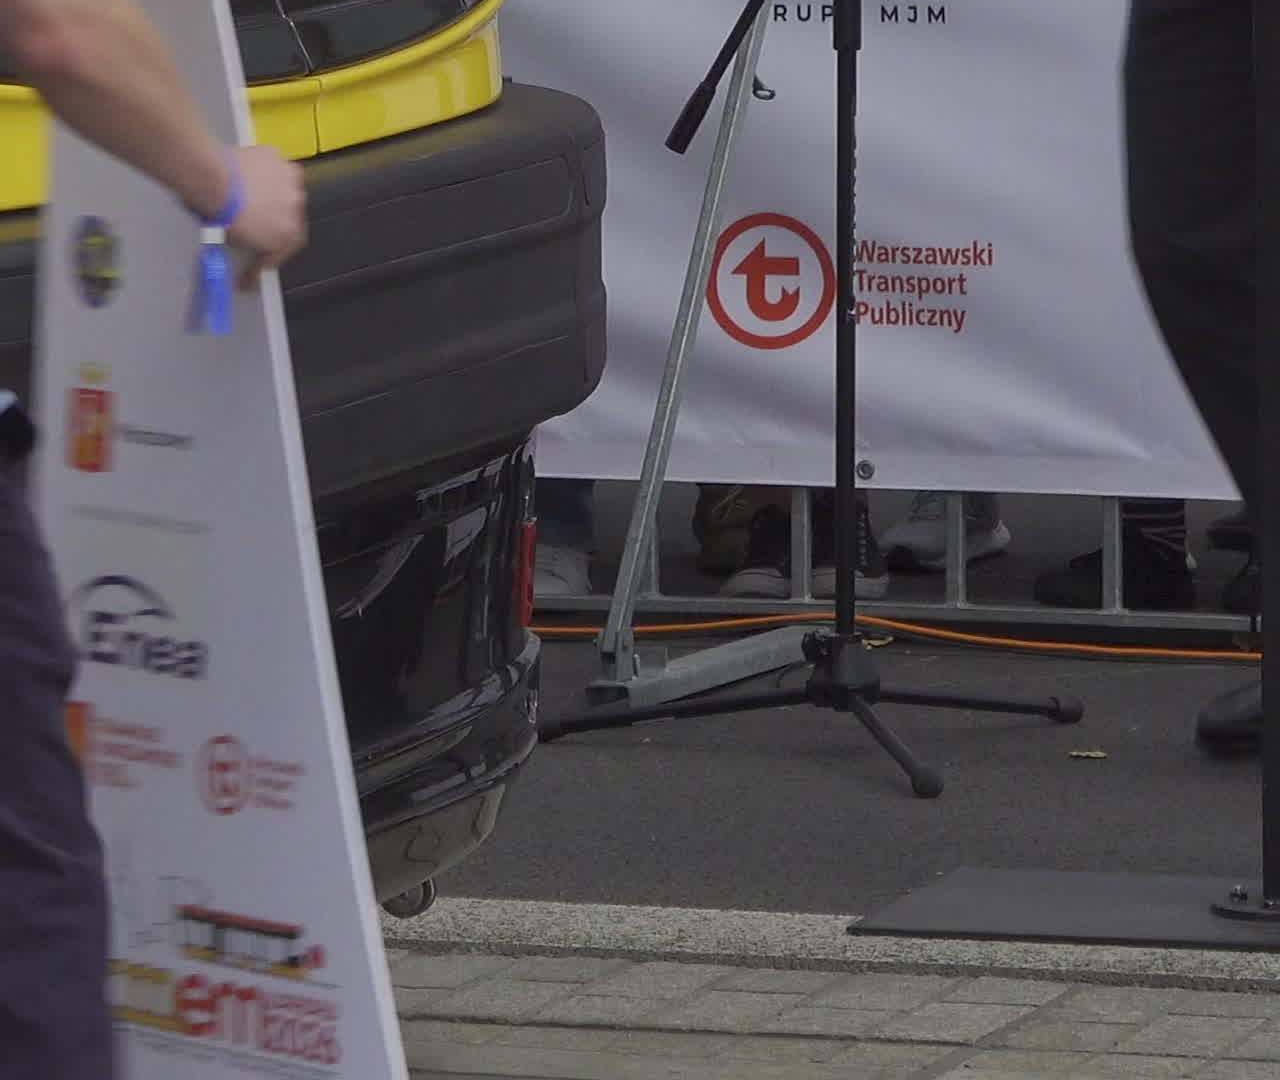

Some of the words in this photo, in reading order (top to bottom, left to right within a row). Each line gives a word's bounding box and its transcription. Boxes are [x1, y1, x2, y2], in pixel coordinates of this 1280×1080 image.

[773, 4, 835, 22] RUP
[880, 4, 947, 25] MJM
[855, 239, 993, 266] Warszawski
[855, 269, 967, 300] Transport
[855, 300, 967, 334] Publiczny
